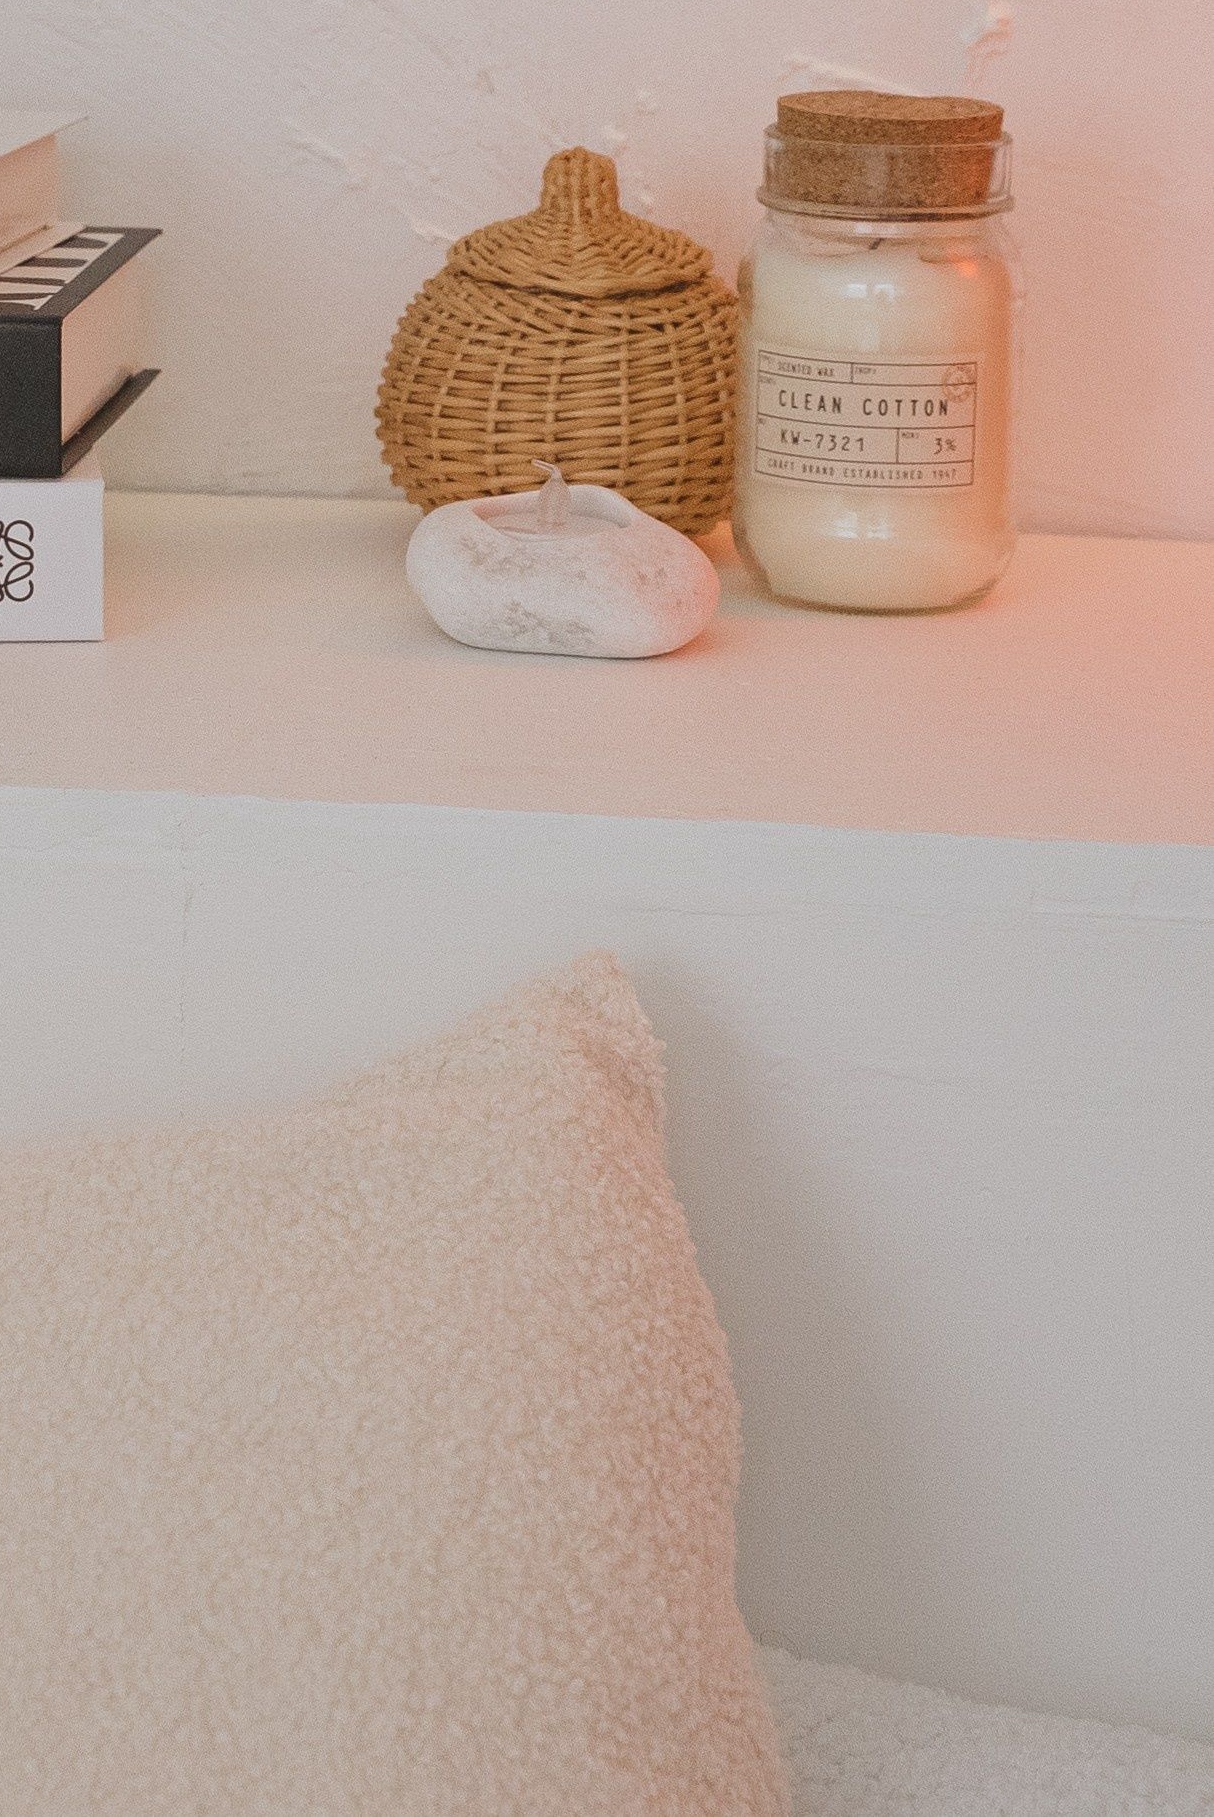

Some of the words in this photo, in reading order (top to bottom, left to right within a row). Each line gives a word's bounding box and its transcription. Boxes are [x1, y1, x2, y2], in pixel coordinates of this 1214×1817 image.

[779, 389, 842, 414] CLEAN
[862, 398, 949, 418] COTTON
[780, 428, 865, 453] KW-7321
[933, 437, 957, 455] 3%
[766, 458, 795, 472] CRAFT
[800, 463, 835, 478] BRAND
[843, 467, 924, 481] ESTABLISHED
